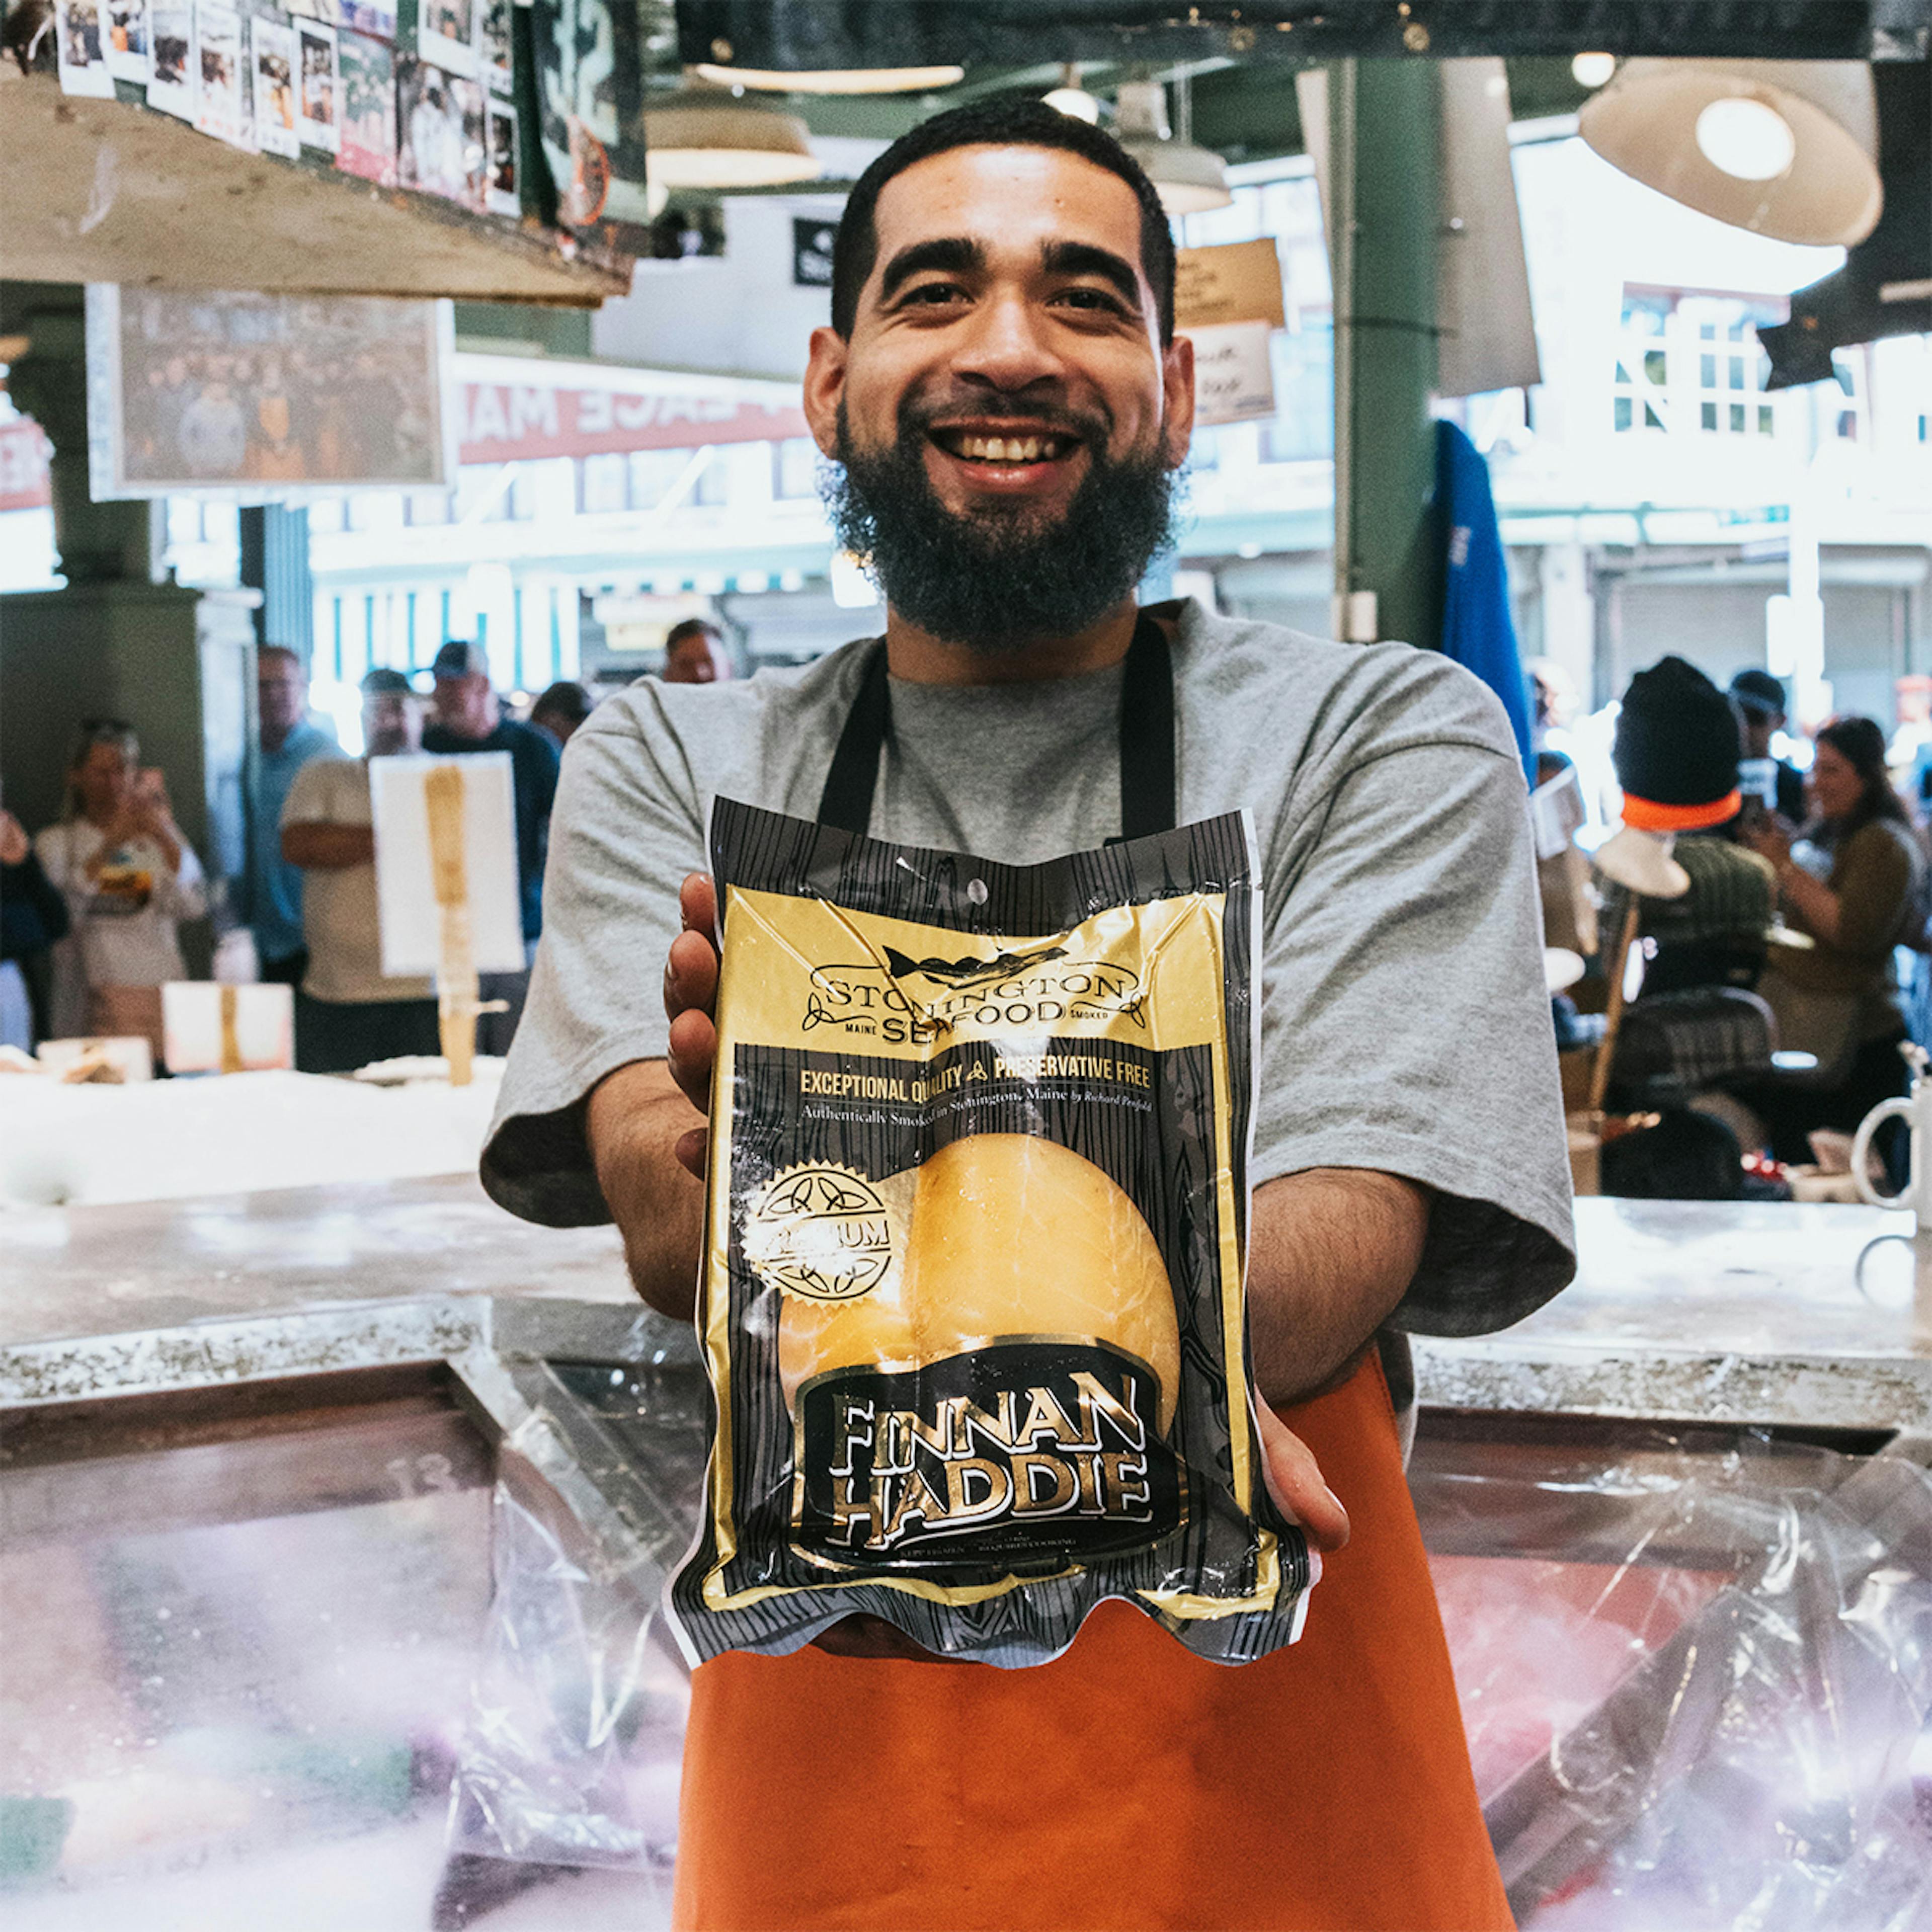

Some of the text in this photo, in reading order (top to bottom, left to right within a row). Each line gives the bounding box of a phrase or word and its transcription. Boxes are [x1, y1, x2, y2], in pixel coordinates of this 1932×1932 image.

[826, 974, 1125, 1017] STONINGTON
[1070, 1009, 1108, 1019] SMOKED
[845, 1023, 877, 1035] MAINE
[882, 1001, 1065, 1045] SEAFOOD
[800, 1055, 1151, 1104] EXCEPTIONAL QUALITY PRESERVATIVE FREE
[801, 1105, 888, 1125] Authentically
[890, 1108, 935, 1127] Smoked
[936, 1106, 948, 1118] in
[1026, 1088, 1068, 1100] Maine
[1070, 1090, 1082, 1102] by
[1084, 1091, 1119, 1105] Richard
[829, 1371, 1145, 1476] FINNAN
[825, 1453, 1153, 1551] HADDIE
